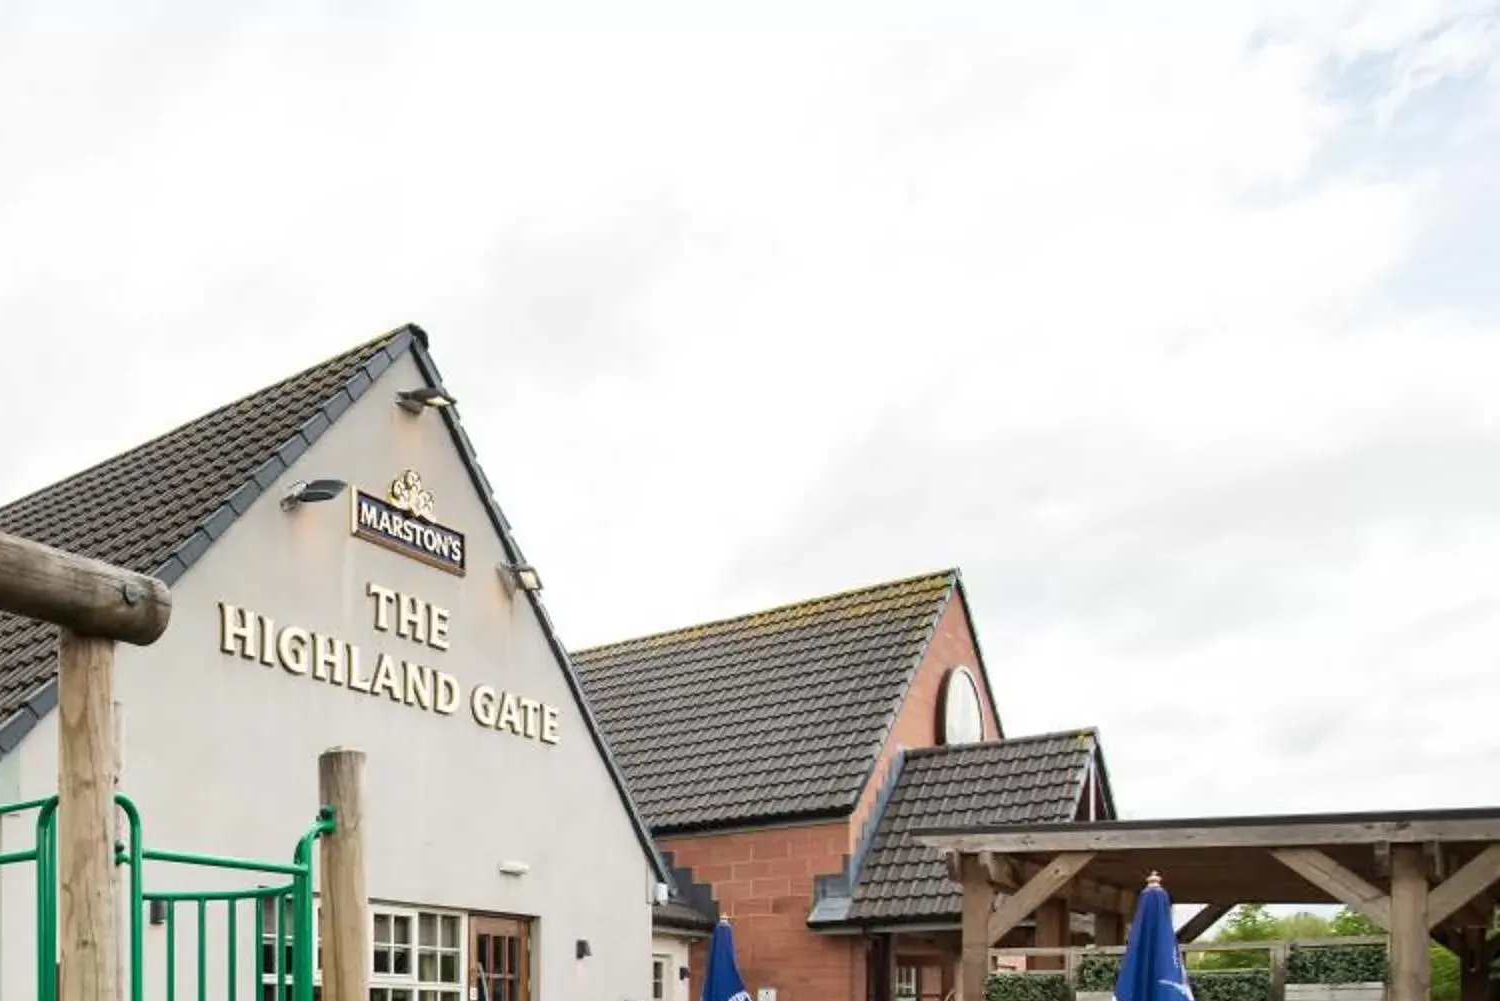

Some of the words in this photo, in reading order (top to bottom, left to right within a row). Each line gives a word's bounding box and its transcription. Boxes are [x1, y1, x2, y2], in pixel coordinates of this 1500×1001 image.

[360, 501, 462, 561] MARSTON'S
[367, 582, 450, 650] THE
[218, 602, 461, 715] HIGHLAND
[470, 684, 561, 743] GATE
